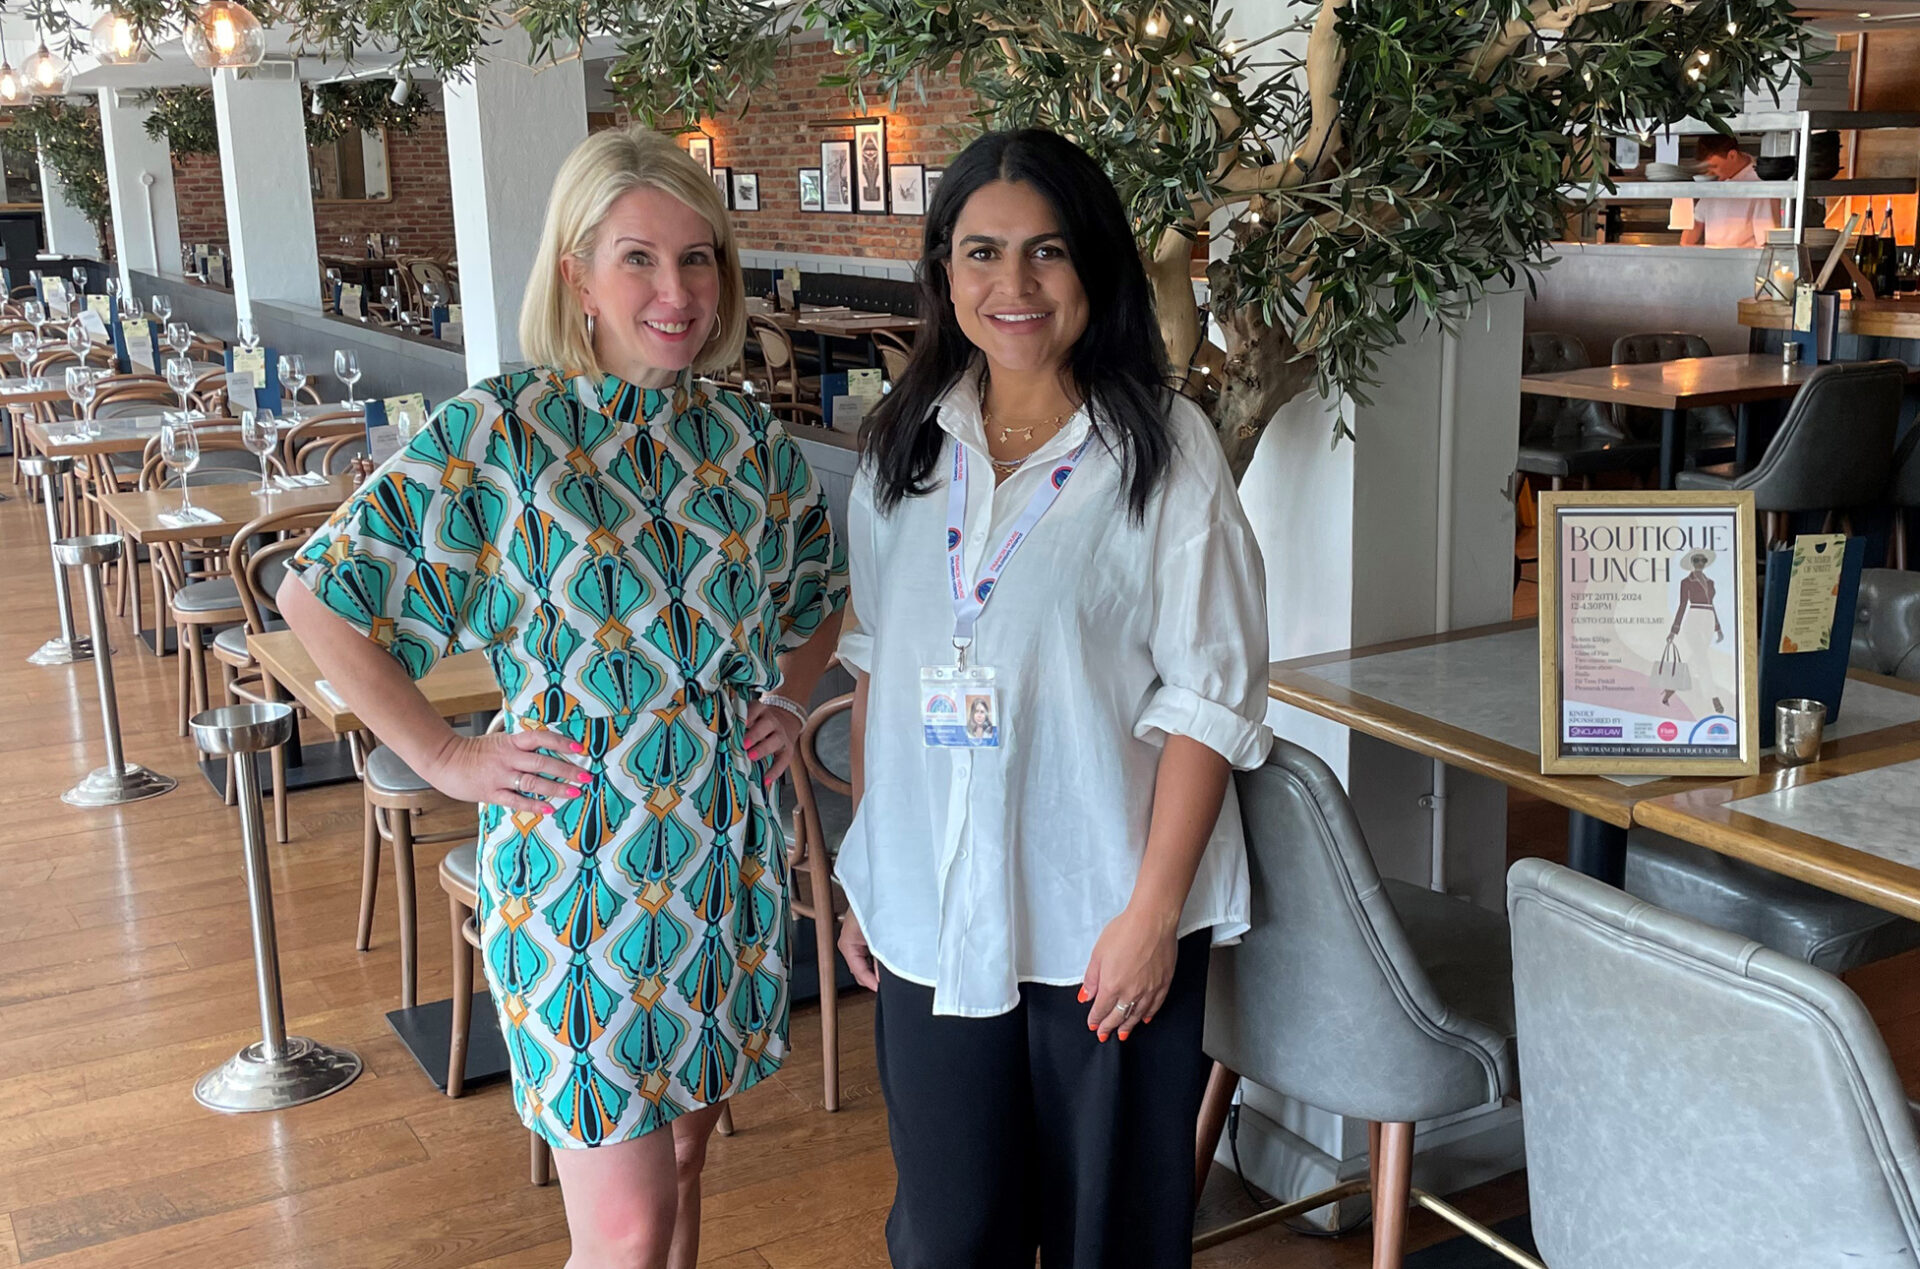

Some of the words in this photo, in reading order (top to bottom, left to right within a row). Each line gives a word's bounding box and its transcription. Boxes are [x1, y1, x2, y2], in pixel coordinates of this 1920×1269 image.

[1571, 526, 1728, 552] BOUTIQUE
[1571, 557, 1670, 583] LUNCH
[1571, 593, 1593, 601] SEPT
[1621, 593, 1642, 601] 2024
[1605, 728, 1621, 736] LAW
